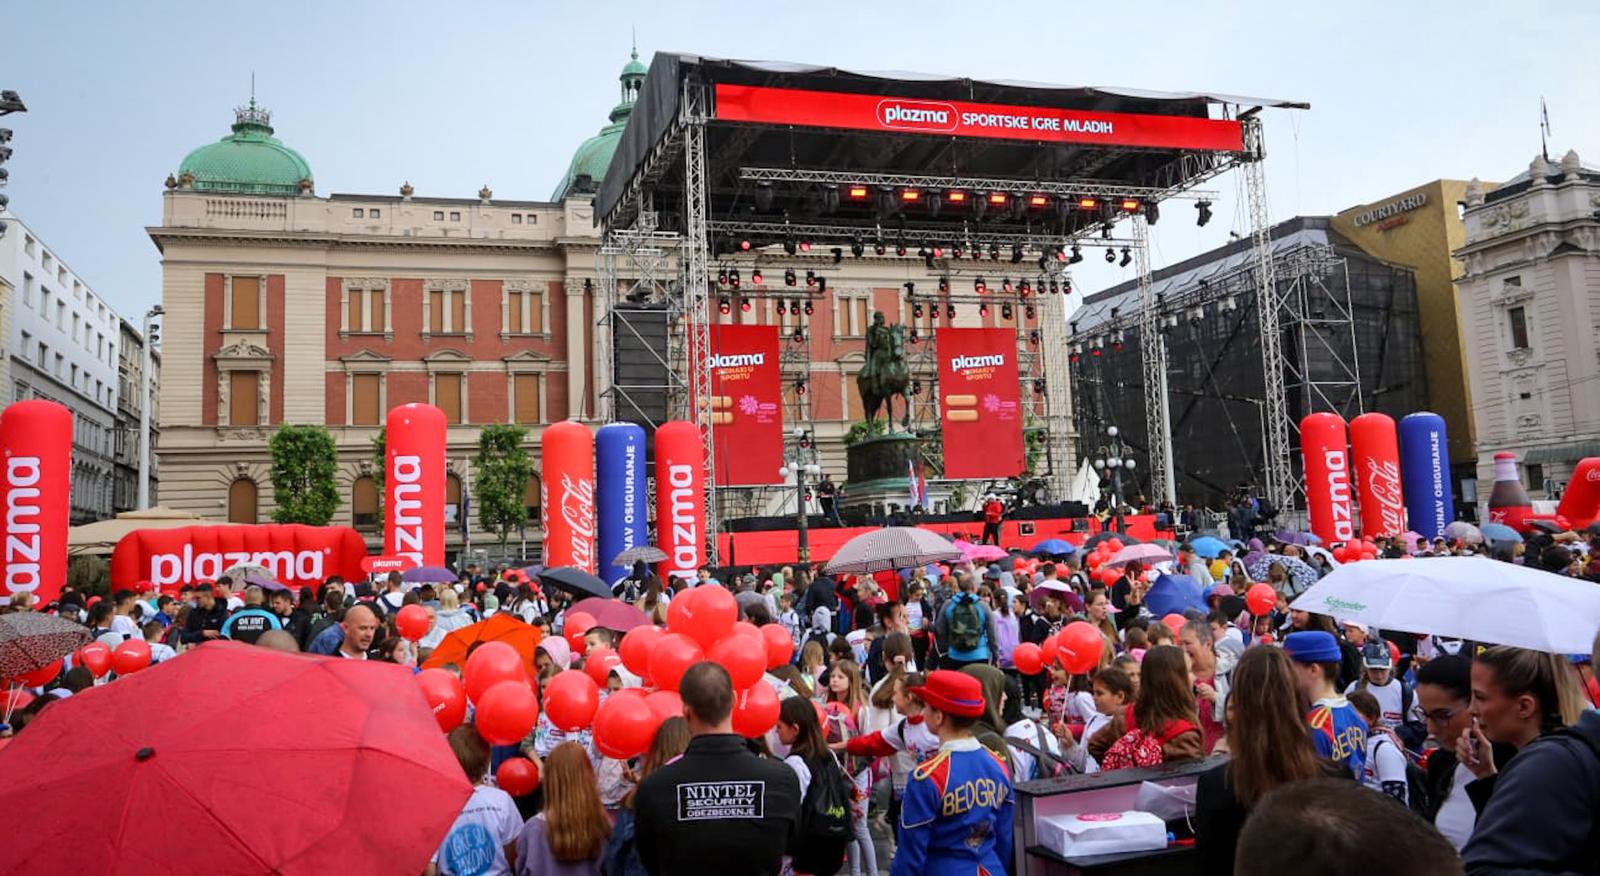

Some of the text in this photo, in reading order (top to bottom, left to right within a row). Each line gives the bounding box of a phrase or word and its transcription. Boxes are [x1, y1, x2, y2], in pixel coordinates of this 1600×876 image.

[885, 104, 948, 123] plazma
[962, 113, 1112, 134] SPORTSKE IGRE MLADIH
[1354, 193, 1427, 227] COURTYARD
[951, 354, 1004, 373] plazma
[0, 456, 41, 606] azma
[686, 785, 756, 799] NINTEL
[686, 797, 755, 807] SECURITY
